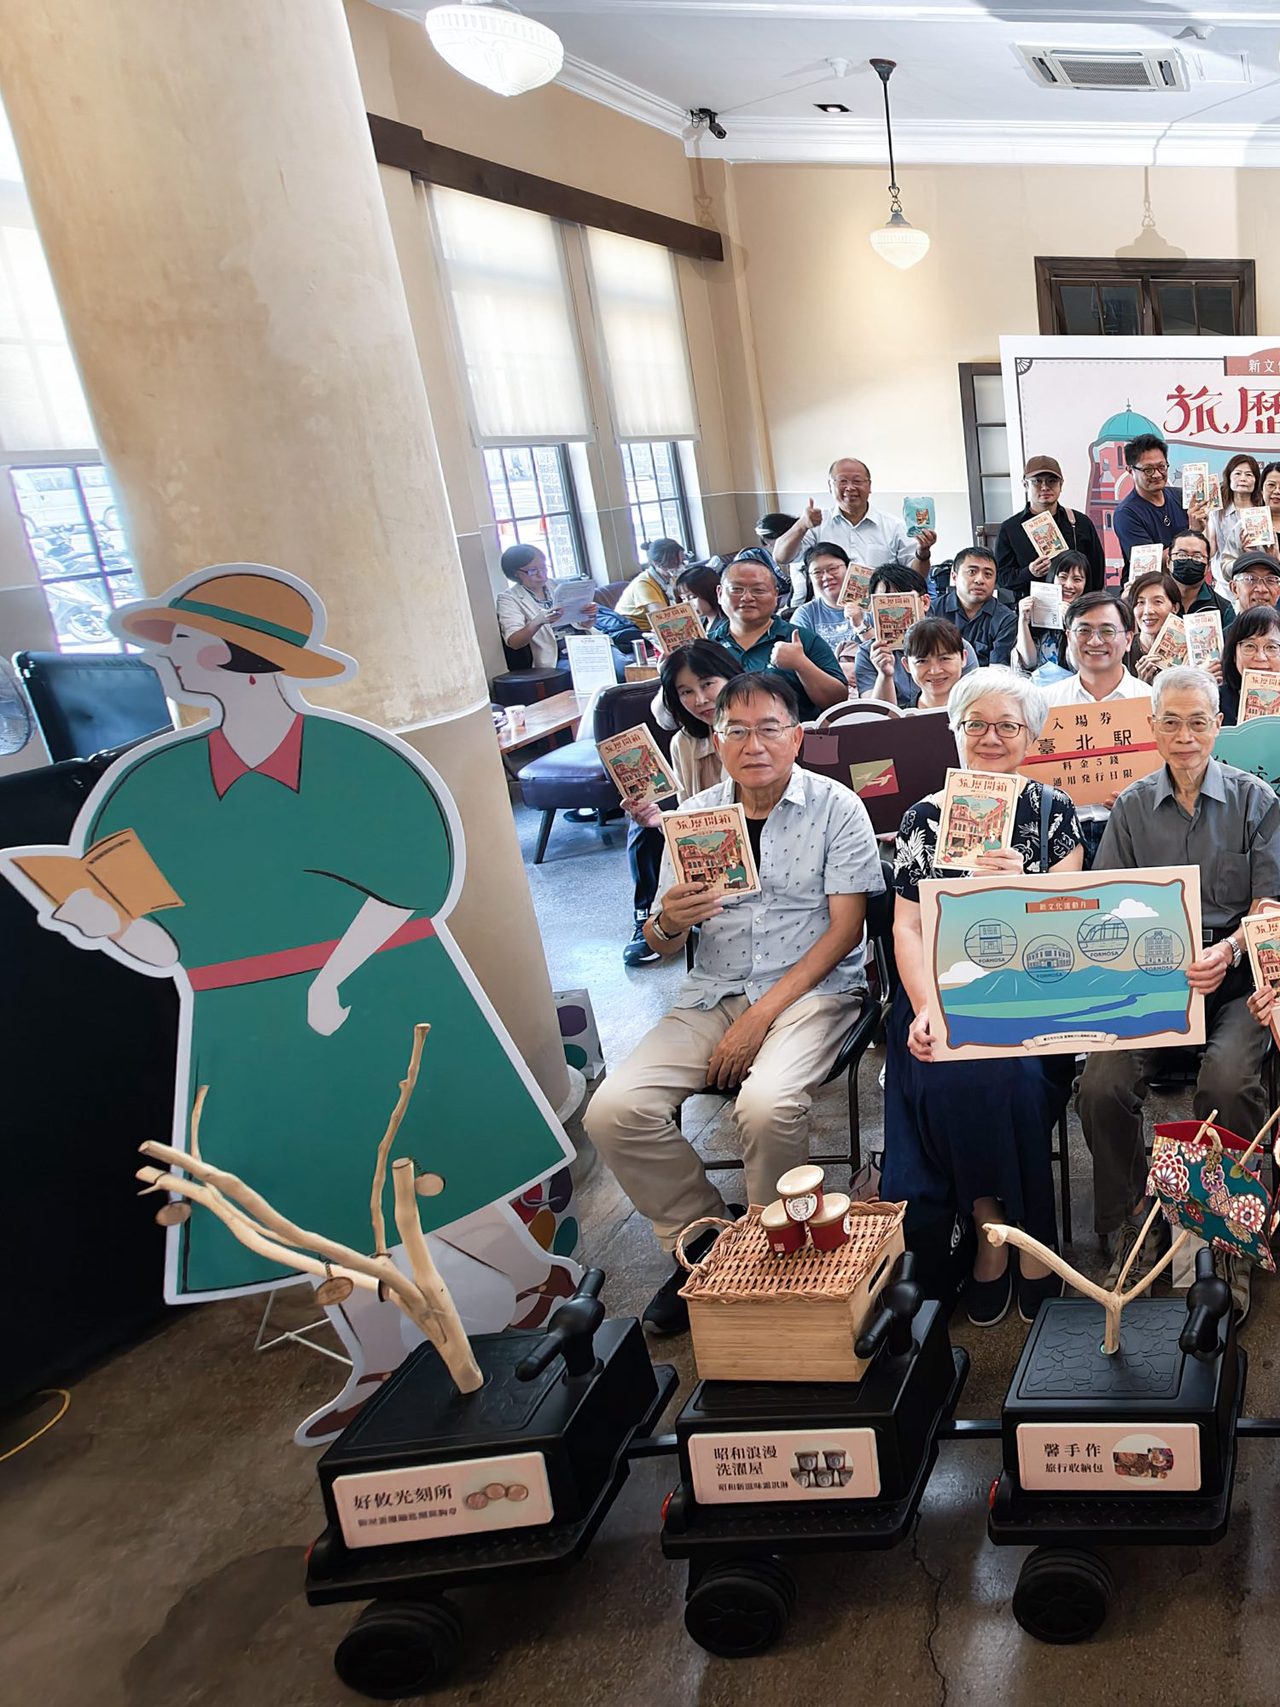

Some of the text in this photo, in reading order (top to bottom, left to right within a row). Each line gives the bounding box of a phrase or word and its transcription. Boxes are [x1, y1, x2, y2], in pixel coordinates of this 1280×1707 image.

[1052, 711, 1112, 731] 入場券
[1037, 729, 1132, 755] 臺北駅
[675, 814, 730, 830] 旅歷開箱
[1039, 901, 1088, 911] 新文化運動月
[714, 1445, 778, 1460] 昭和浪漫
[716, 1461, 763, 1476] 洗濯屋
[1045, 1462, 1104, 1473] 旅行收納包
